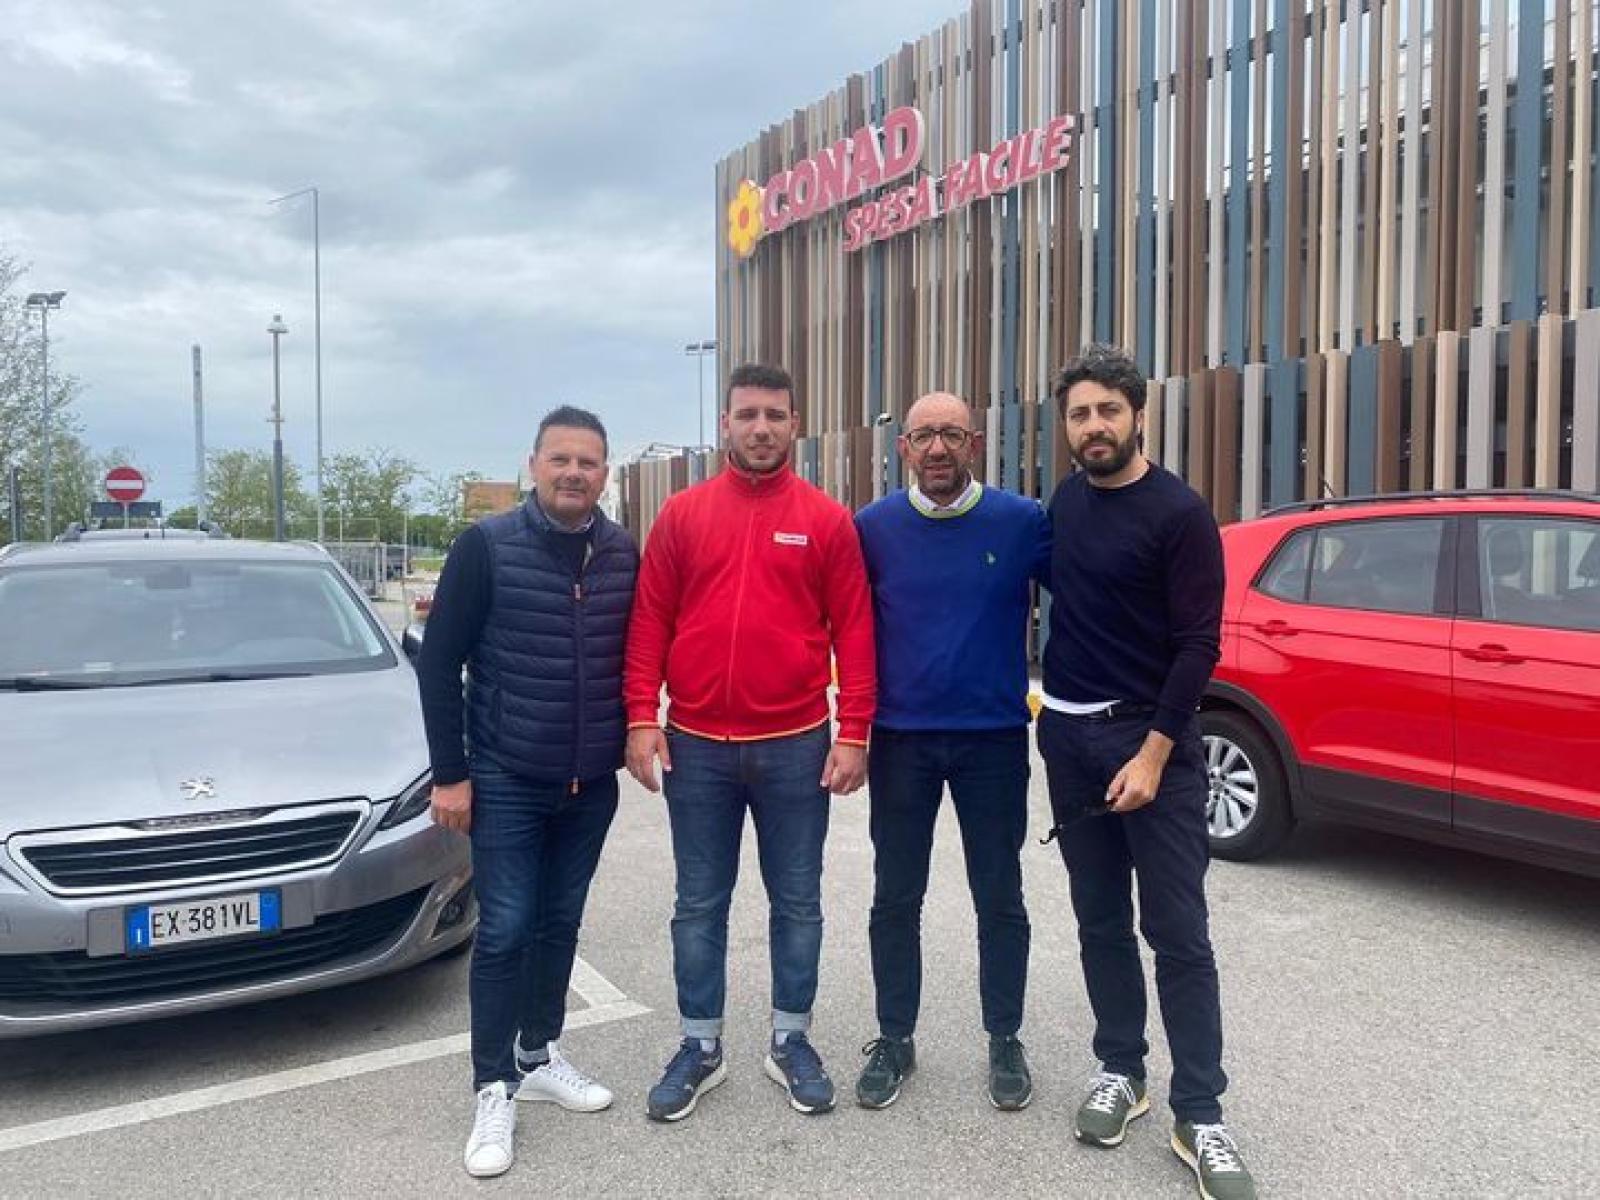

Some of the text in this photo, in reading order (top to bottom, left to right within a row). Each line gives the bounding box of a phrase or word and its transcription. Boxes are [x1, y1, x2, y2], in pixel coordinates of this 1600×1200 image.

[763, 106, 924, 232] CONAD
[843, 114, 1074, 251] SPESA FACILE
[151, 910, 181, 939] EX
[188, 901, 259, 933] 381VL
